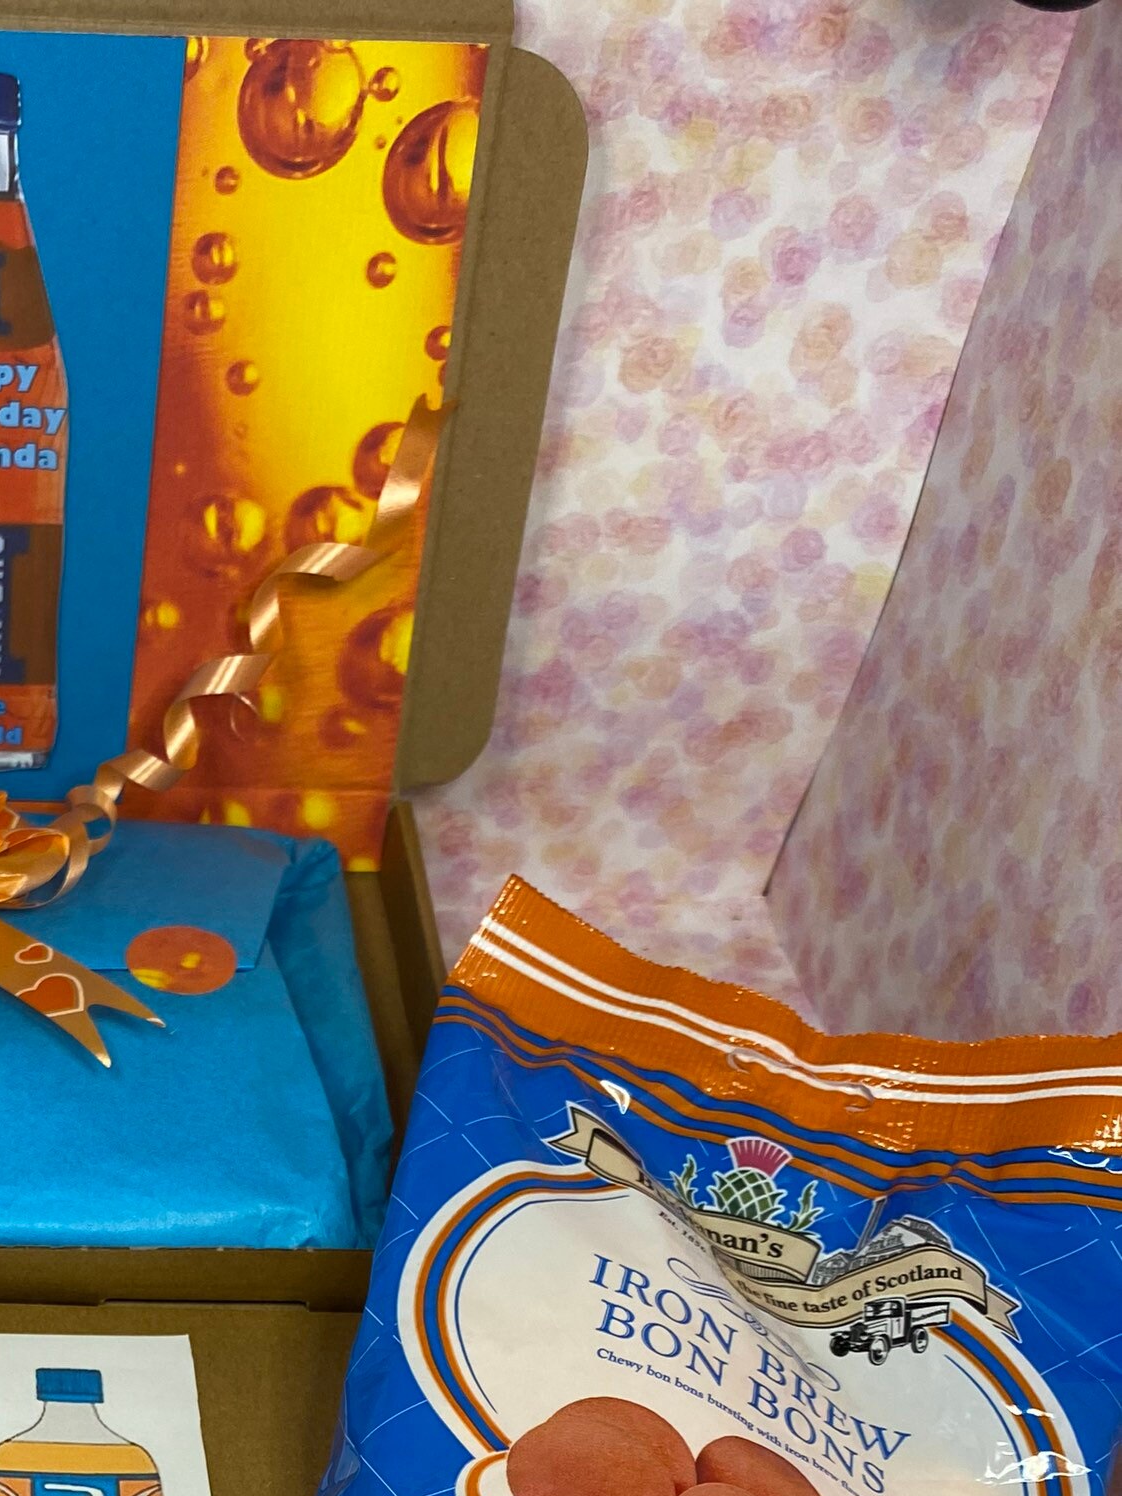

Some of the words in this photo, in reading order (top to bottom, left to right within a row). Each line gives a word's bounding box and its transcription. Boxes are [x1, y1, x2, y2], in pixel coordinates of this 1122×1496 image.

[588, 1252, 739, 1355] IRON
[757, 1344, 912, 1460] BREW
[763, 1292, 799, 1312] fine
[801, 1297, 848, 1313] taste
[852, 1280, 873, 1301] of
[874, 1264, 963, 1292] Scotland
[595, 1299, 730, 1387] BON
[747, 1375, 885, 1494] BONS
[597, 1348, 643, 1373] Chewy
[647, 1365, 672, 1383] bon
[675, 1377, 704, 1399] bons
[707, 1393, 755, 1431] bursting
[757, 1427, 782, 1448] with
[784, 1443, 809, 1464] iron
[812, 1458, 839, 1482] brew
